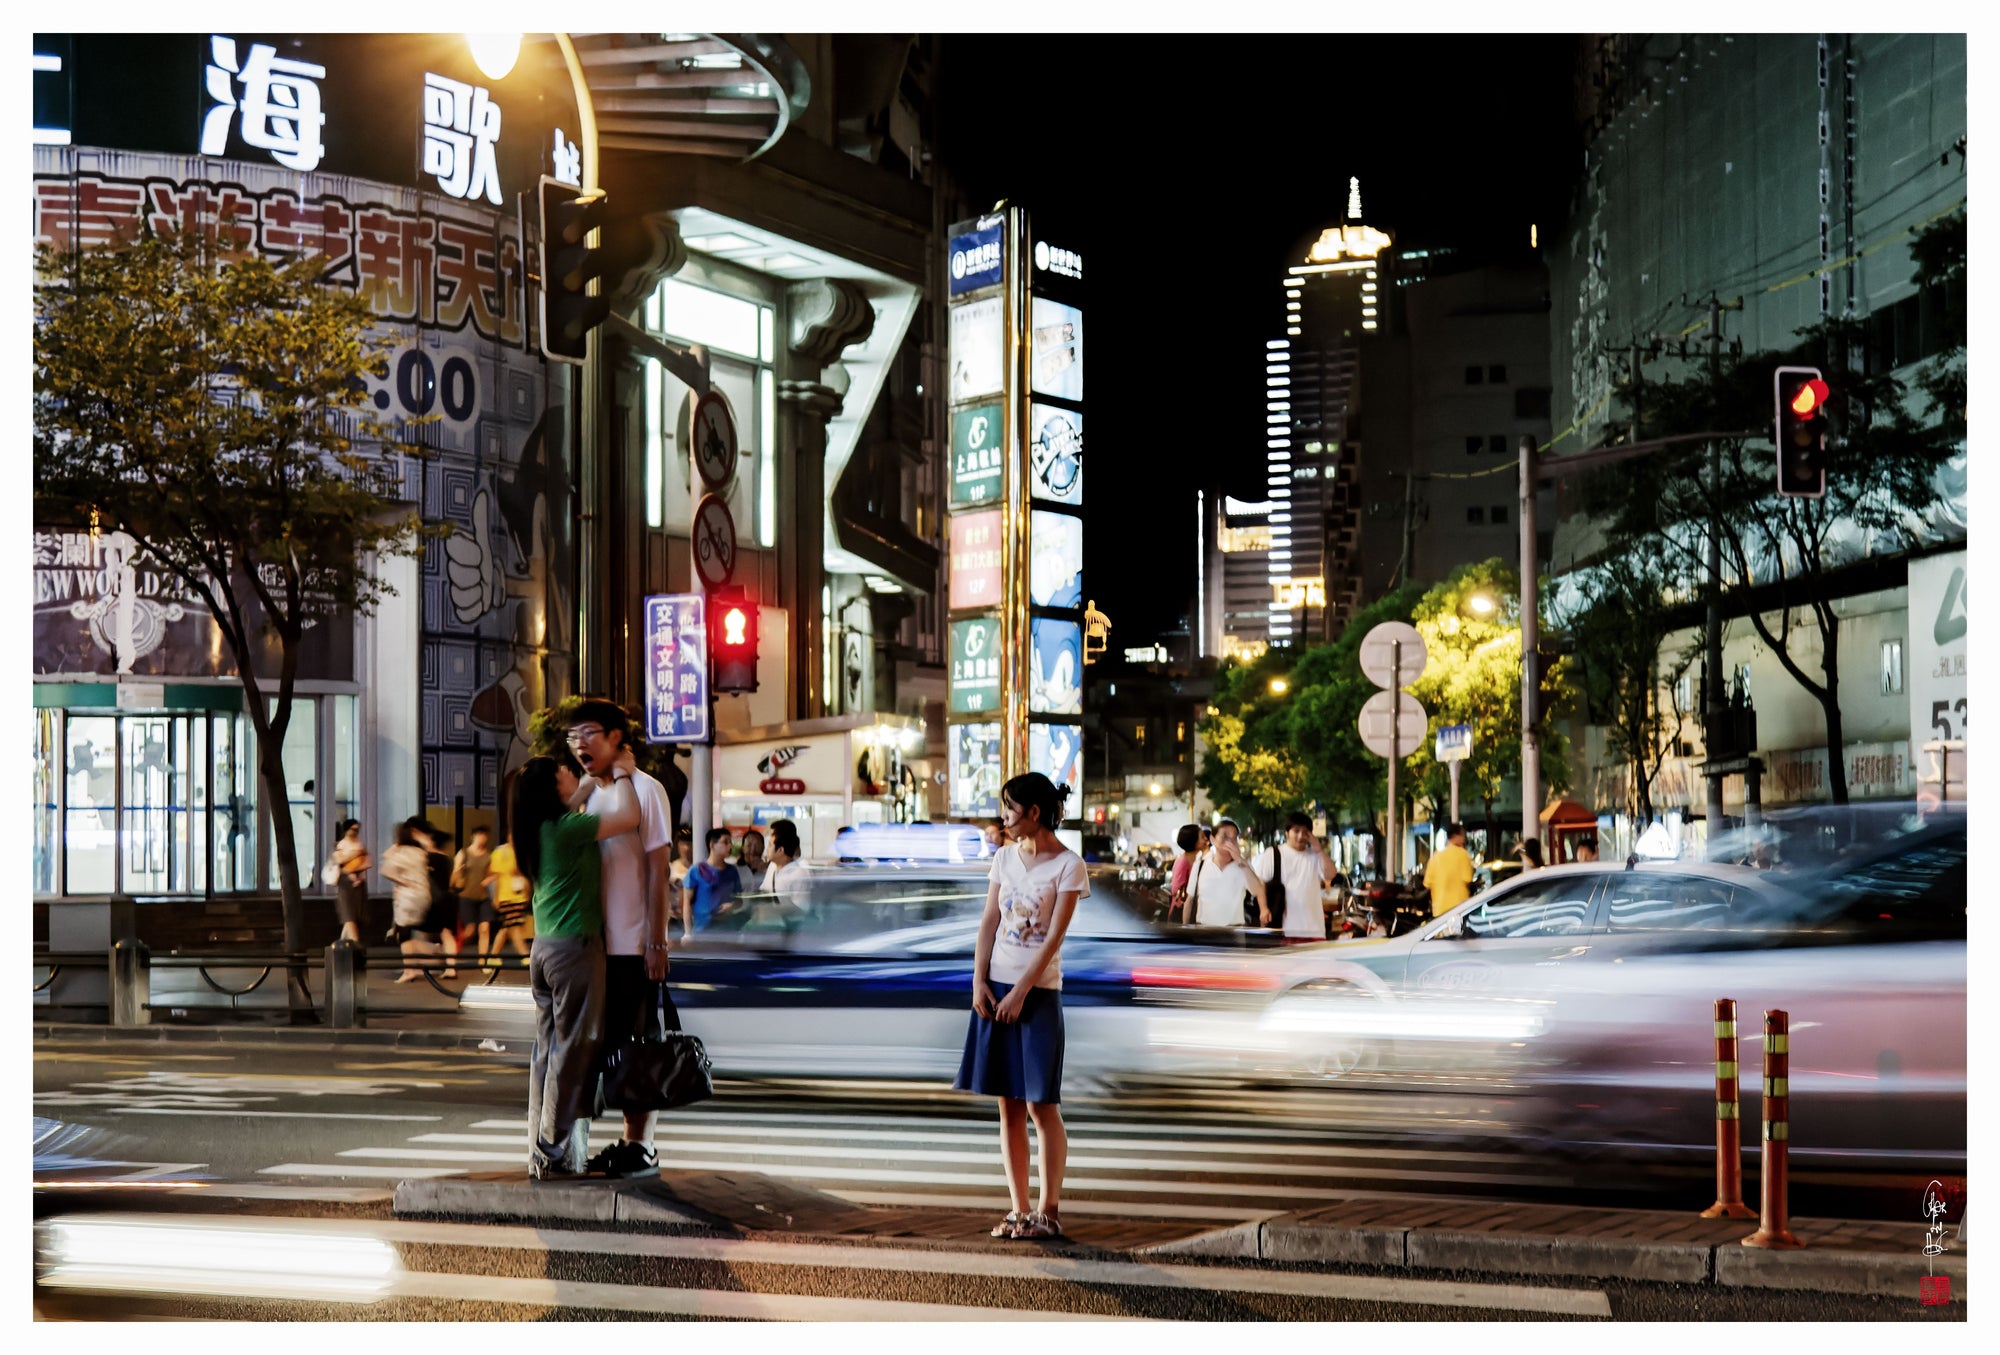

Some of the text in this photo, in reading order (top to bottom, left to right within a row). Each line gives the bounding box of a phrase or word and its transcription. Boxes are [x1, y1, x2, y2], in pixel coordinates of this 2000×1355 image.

[350, 348, 475, 421] :00
[656, 604, 674, 735] 交通文明指数
